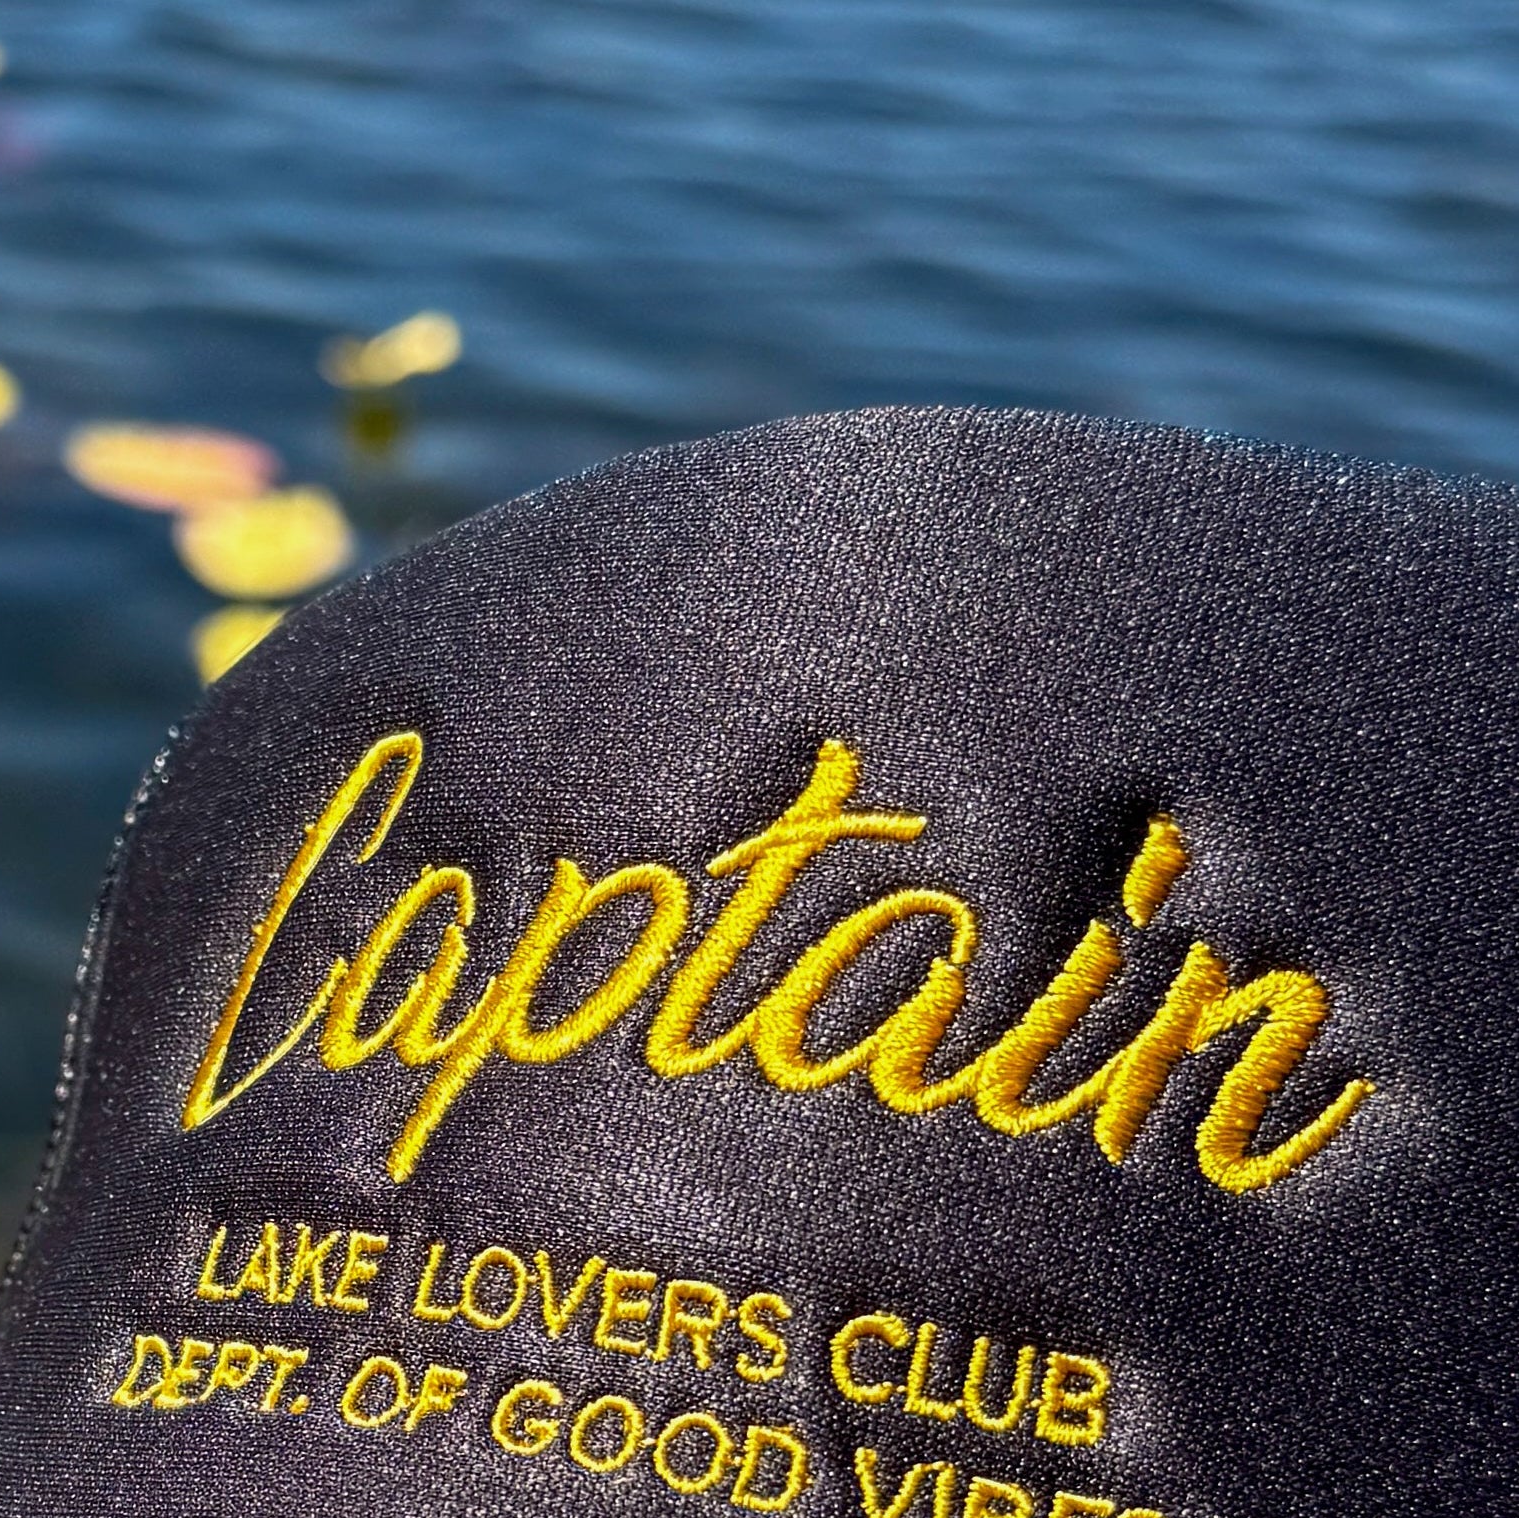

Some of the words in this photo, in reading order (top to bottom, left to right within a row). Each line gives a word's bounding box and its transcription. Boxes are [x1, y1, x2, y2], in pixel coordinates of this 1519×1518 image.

[180, 731, 1377, 1196] Captain
[109, 1334, 311, 1415] DEPT.
[338, 1354, 469, 1433] OF
[490, 1377, 813, 1513] GOOD
[194, 1222, 391, 1313] LAKE
[410, 1241, 791, 1383] LOVERS
[829, 1311, 1113, 1448] CLUB
